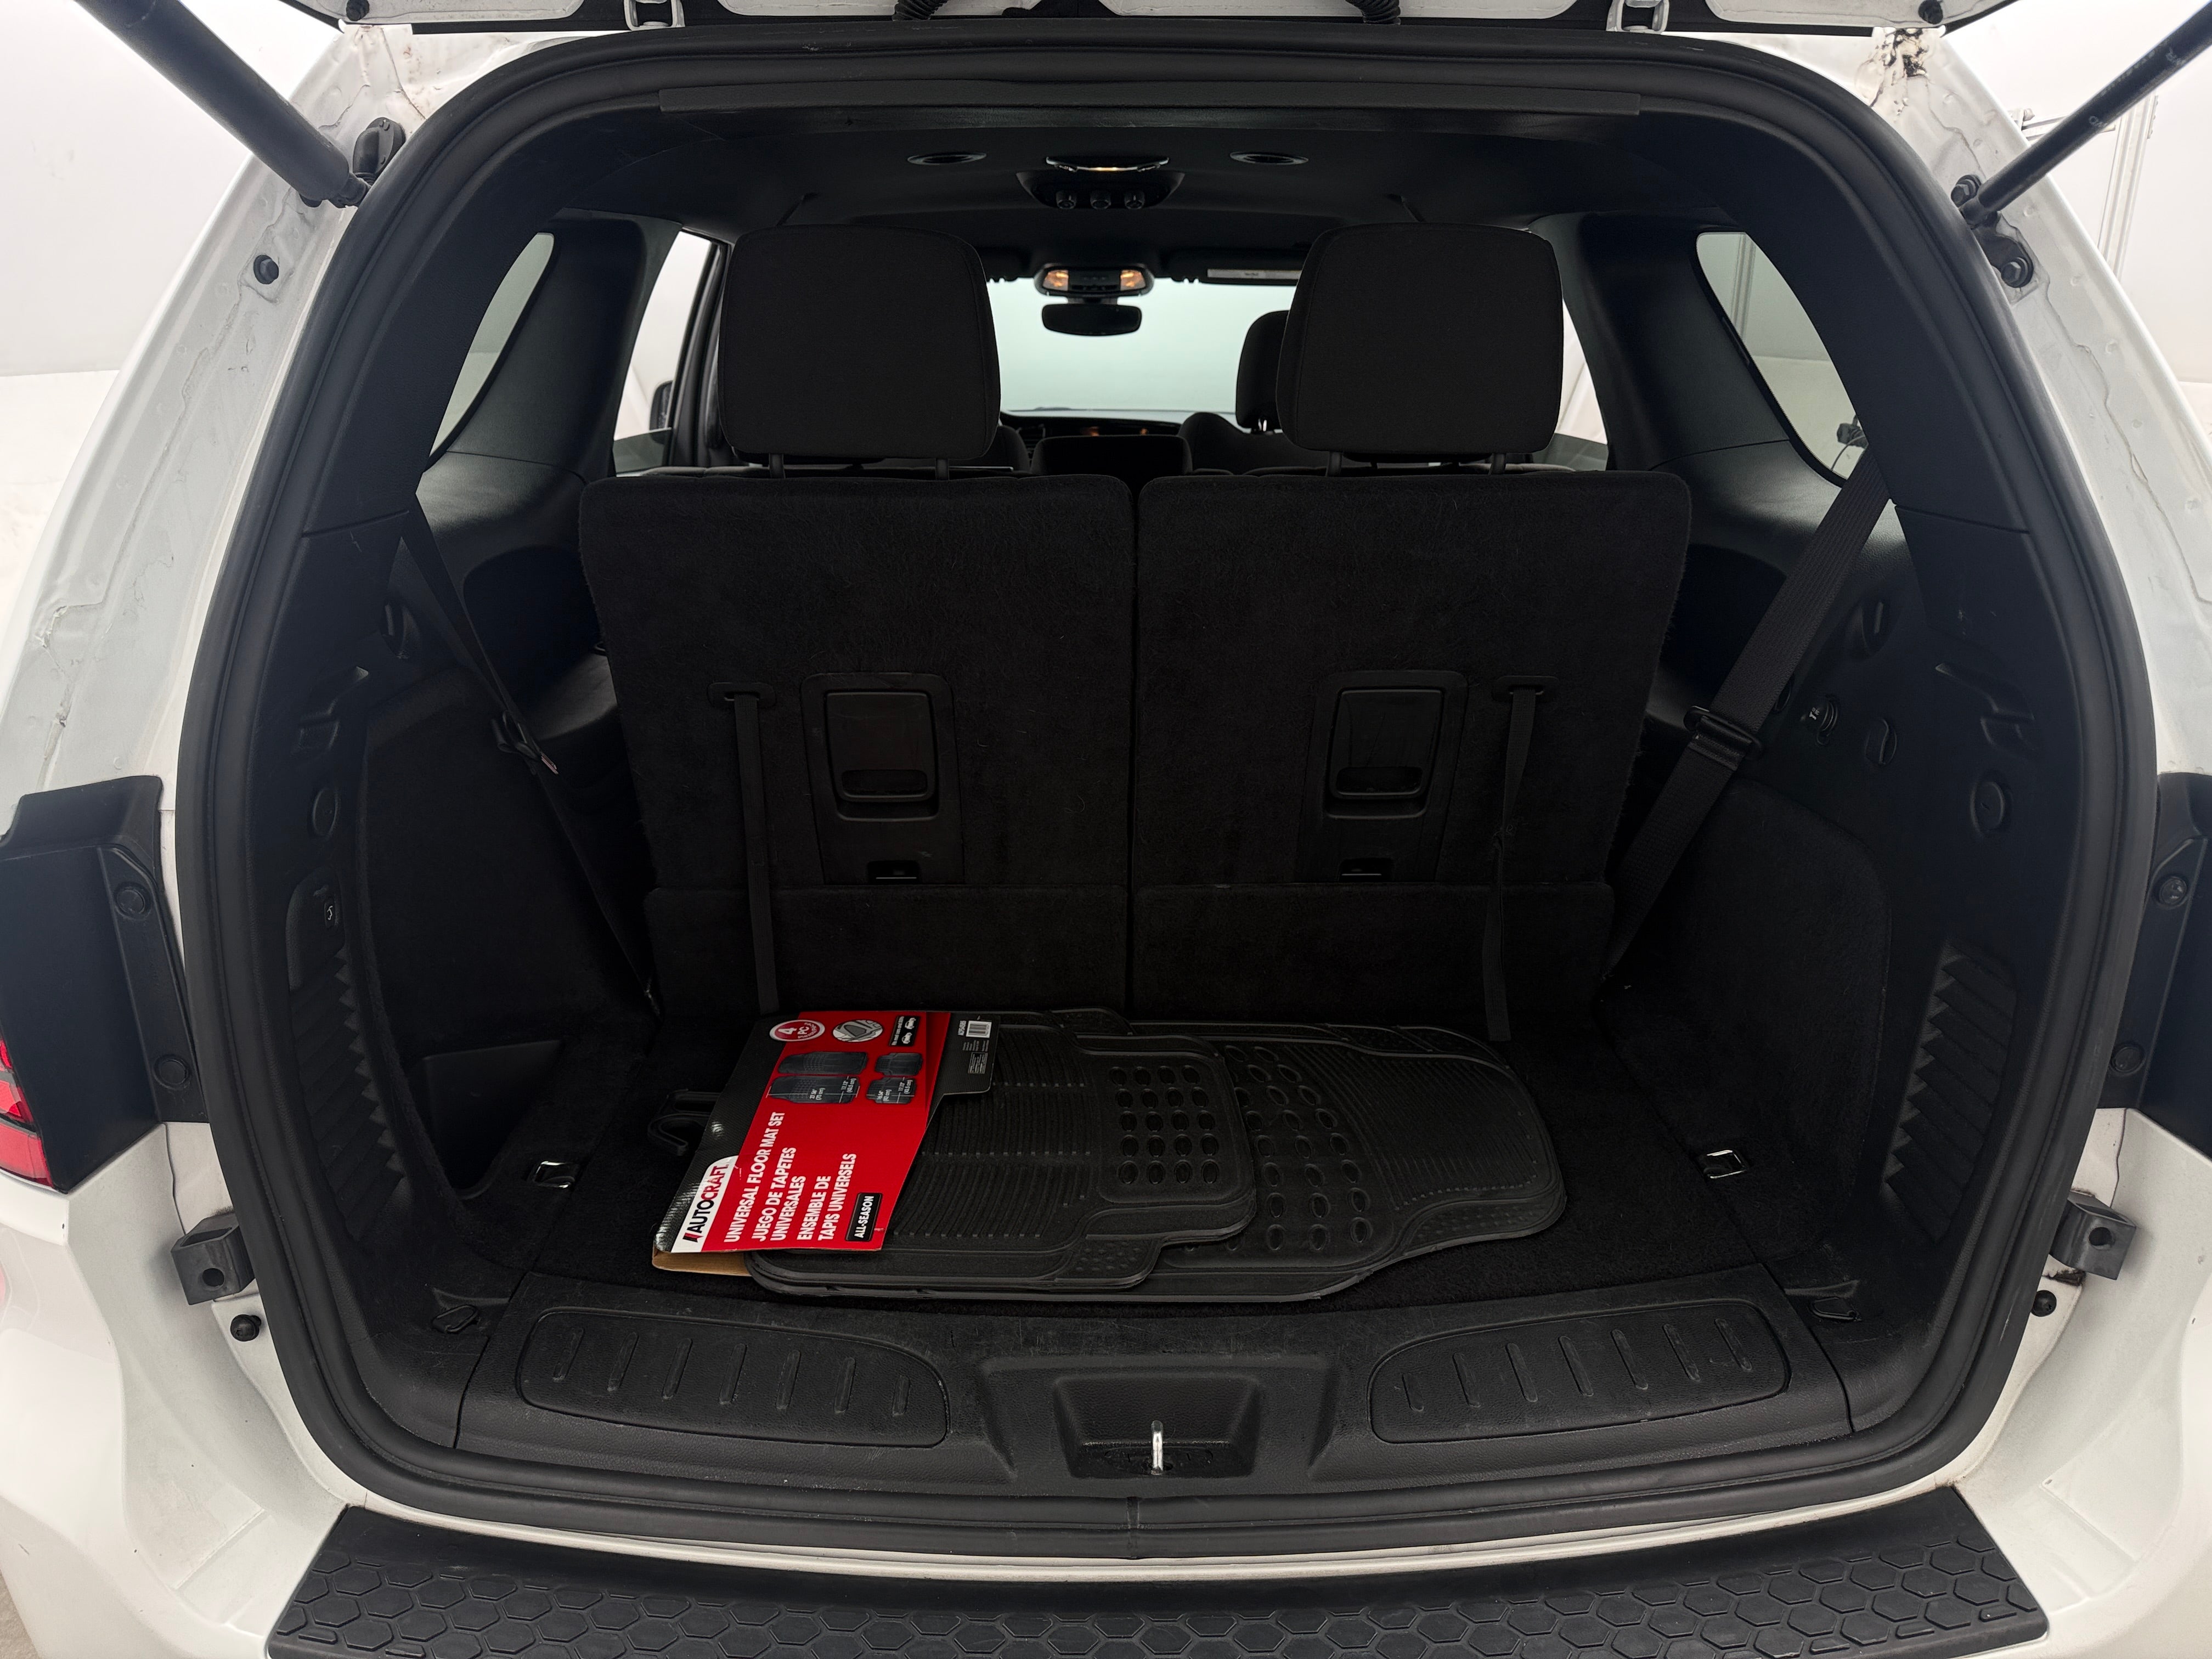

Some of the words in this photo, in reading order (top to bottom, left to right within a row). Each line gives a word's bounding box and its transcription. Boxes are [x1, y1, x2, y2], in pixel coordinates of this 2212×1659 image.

[797, 1026, 809, 1035] PC
[759, 1127, 779, 1147] MAT
[768, 1111, 785, 1127] SET
[747, 1149, 771, 1183] FLOOR
[770, 1147, 797, 1189] TAPETES
[827, 1153, 857, 1212] UNIVERSELS
[686, 1165, 729, 1233] AUTOCRAFT
[724, 1186, 759, 1242] UNIVERSAL
[765, 1191, 783, 1206] DE
[770, 1176, 806, 1241] UNIVERSALES
[797, 1192, 826, 1240] ENSEMBLE
[814, 1176, 831, 1190] DE
[854, 1195, 874, 1238] ALL-SEASON
[752, 1207, 777, 1242] JUEGO
[817, 1213, 840, 1241] TAPIS
